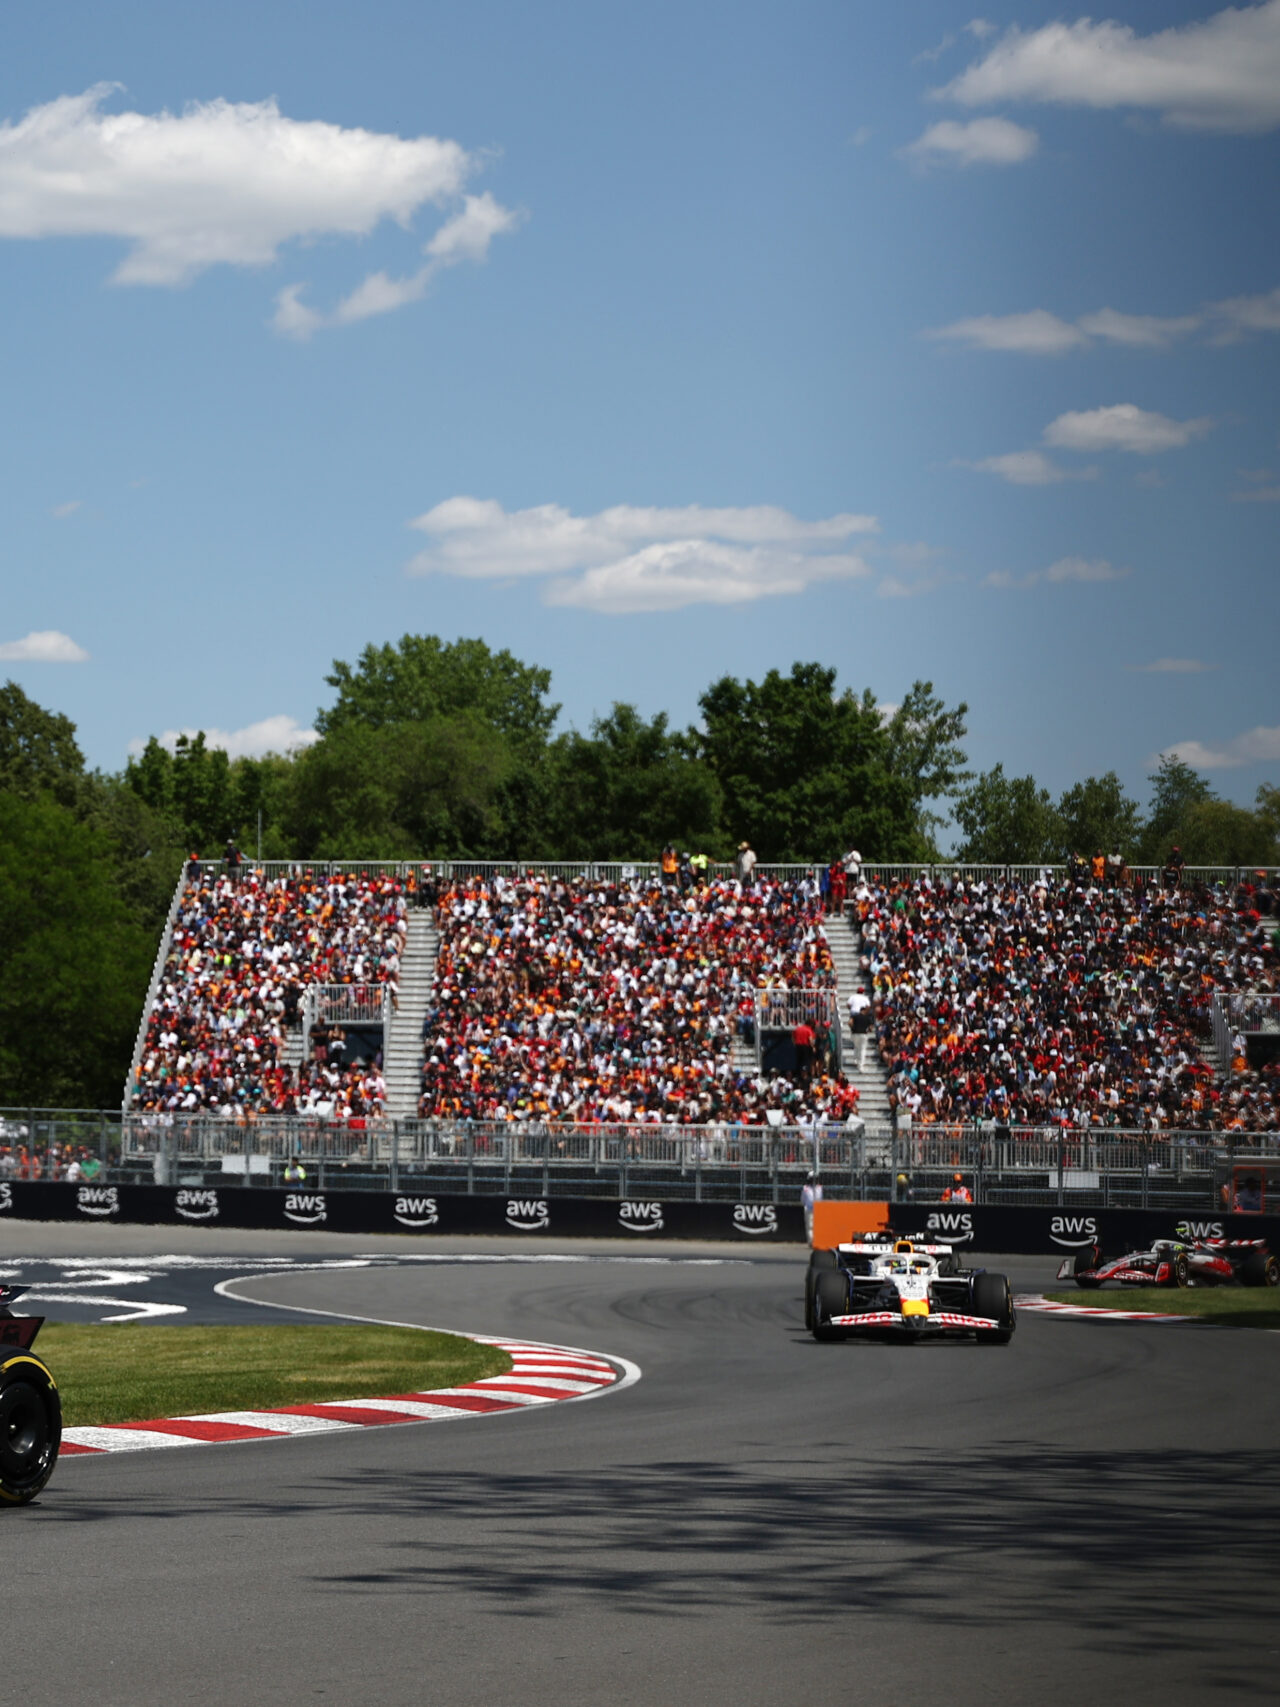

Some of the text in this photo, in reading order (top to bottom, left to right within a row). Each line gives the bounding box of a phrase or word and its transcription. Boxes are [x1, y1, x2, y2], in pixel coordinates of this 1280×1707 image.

[77, 1186, 118, 1203] aws
[176, 1189, 218, 1206] aws
[285, 1194, 326, 1211] aws
[395, 1197, 437, 1213] aws
[506, 1201, 548, 1216] aws
[619, 1202, 662, 1218] aws
[733, 1205, 776, 1221] aws
[927, 1213, 973, 1230] aws
[1051, 1216, 1097, 1234] aws
[1177, 1220, 1224, 1239] aws
